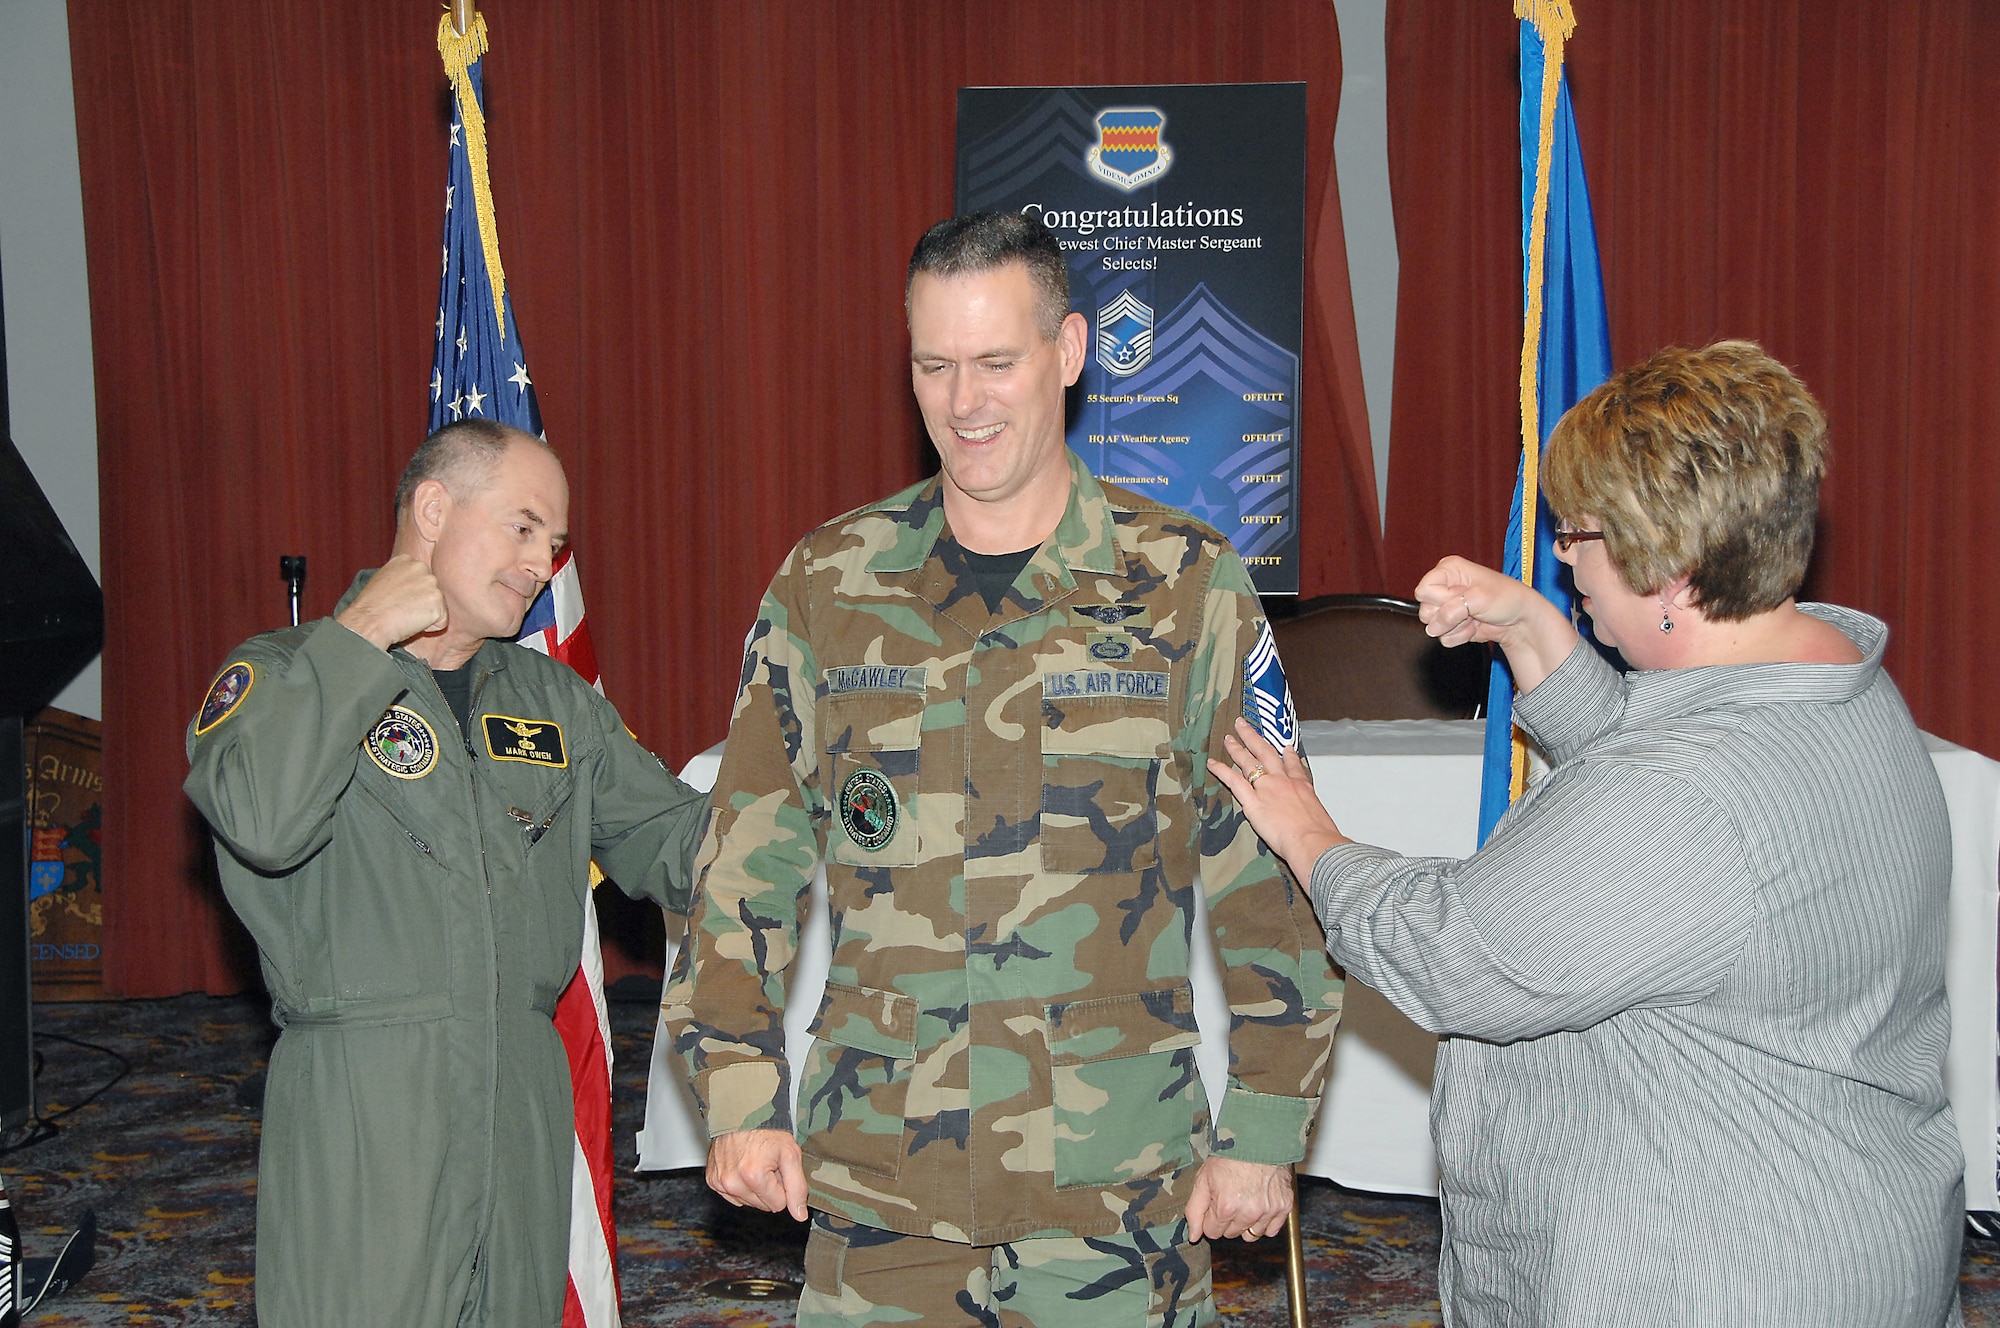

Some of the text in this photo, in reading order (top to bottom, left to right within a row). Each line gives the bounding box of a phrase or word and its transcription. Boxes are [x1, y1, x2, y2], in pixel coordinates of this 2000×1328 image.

[1134, 165, 1161, 182] OMNIA
[1056, 235, 1262, 252] ewest Chief Master Sergeant
[1103, 256, 1158, 270] Selects!
[1087, 394, 1179, 404] 55 Security Forces Sq
[1243, 393, 1284, 402] OFFUTT
[1089, 434, 1191, 444] HQ AF Weather Agency
[1242, 434, 1283, 443] OFFUTT
[1101, 474, 1169, 485] Maintenance Sq
[1241, 474, 1283, 483] OFFUTT
[1240, 515, 1282, 524] OFFUTT
[1241, 556, 1282, 565] OFFUTT
[1051, 672, 1164, 695] U.S. AIR FORCE
[394, 711, 422, 730] STATES
[505, 746, 552, 760] MARK OWEN
[371, 746, 409, 774] STRATEGIC
